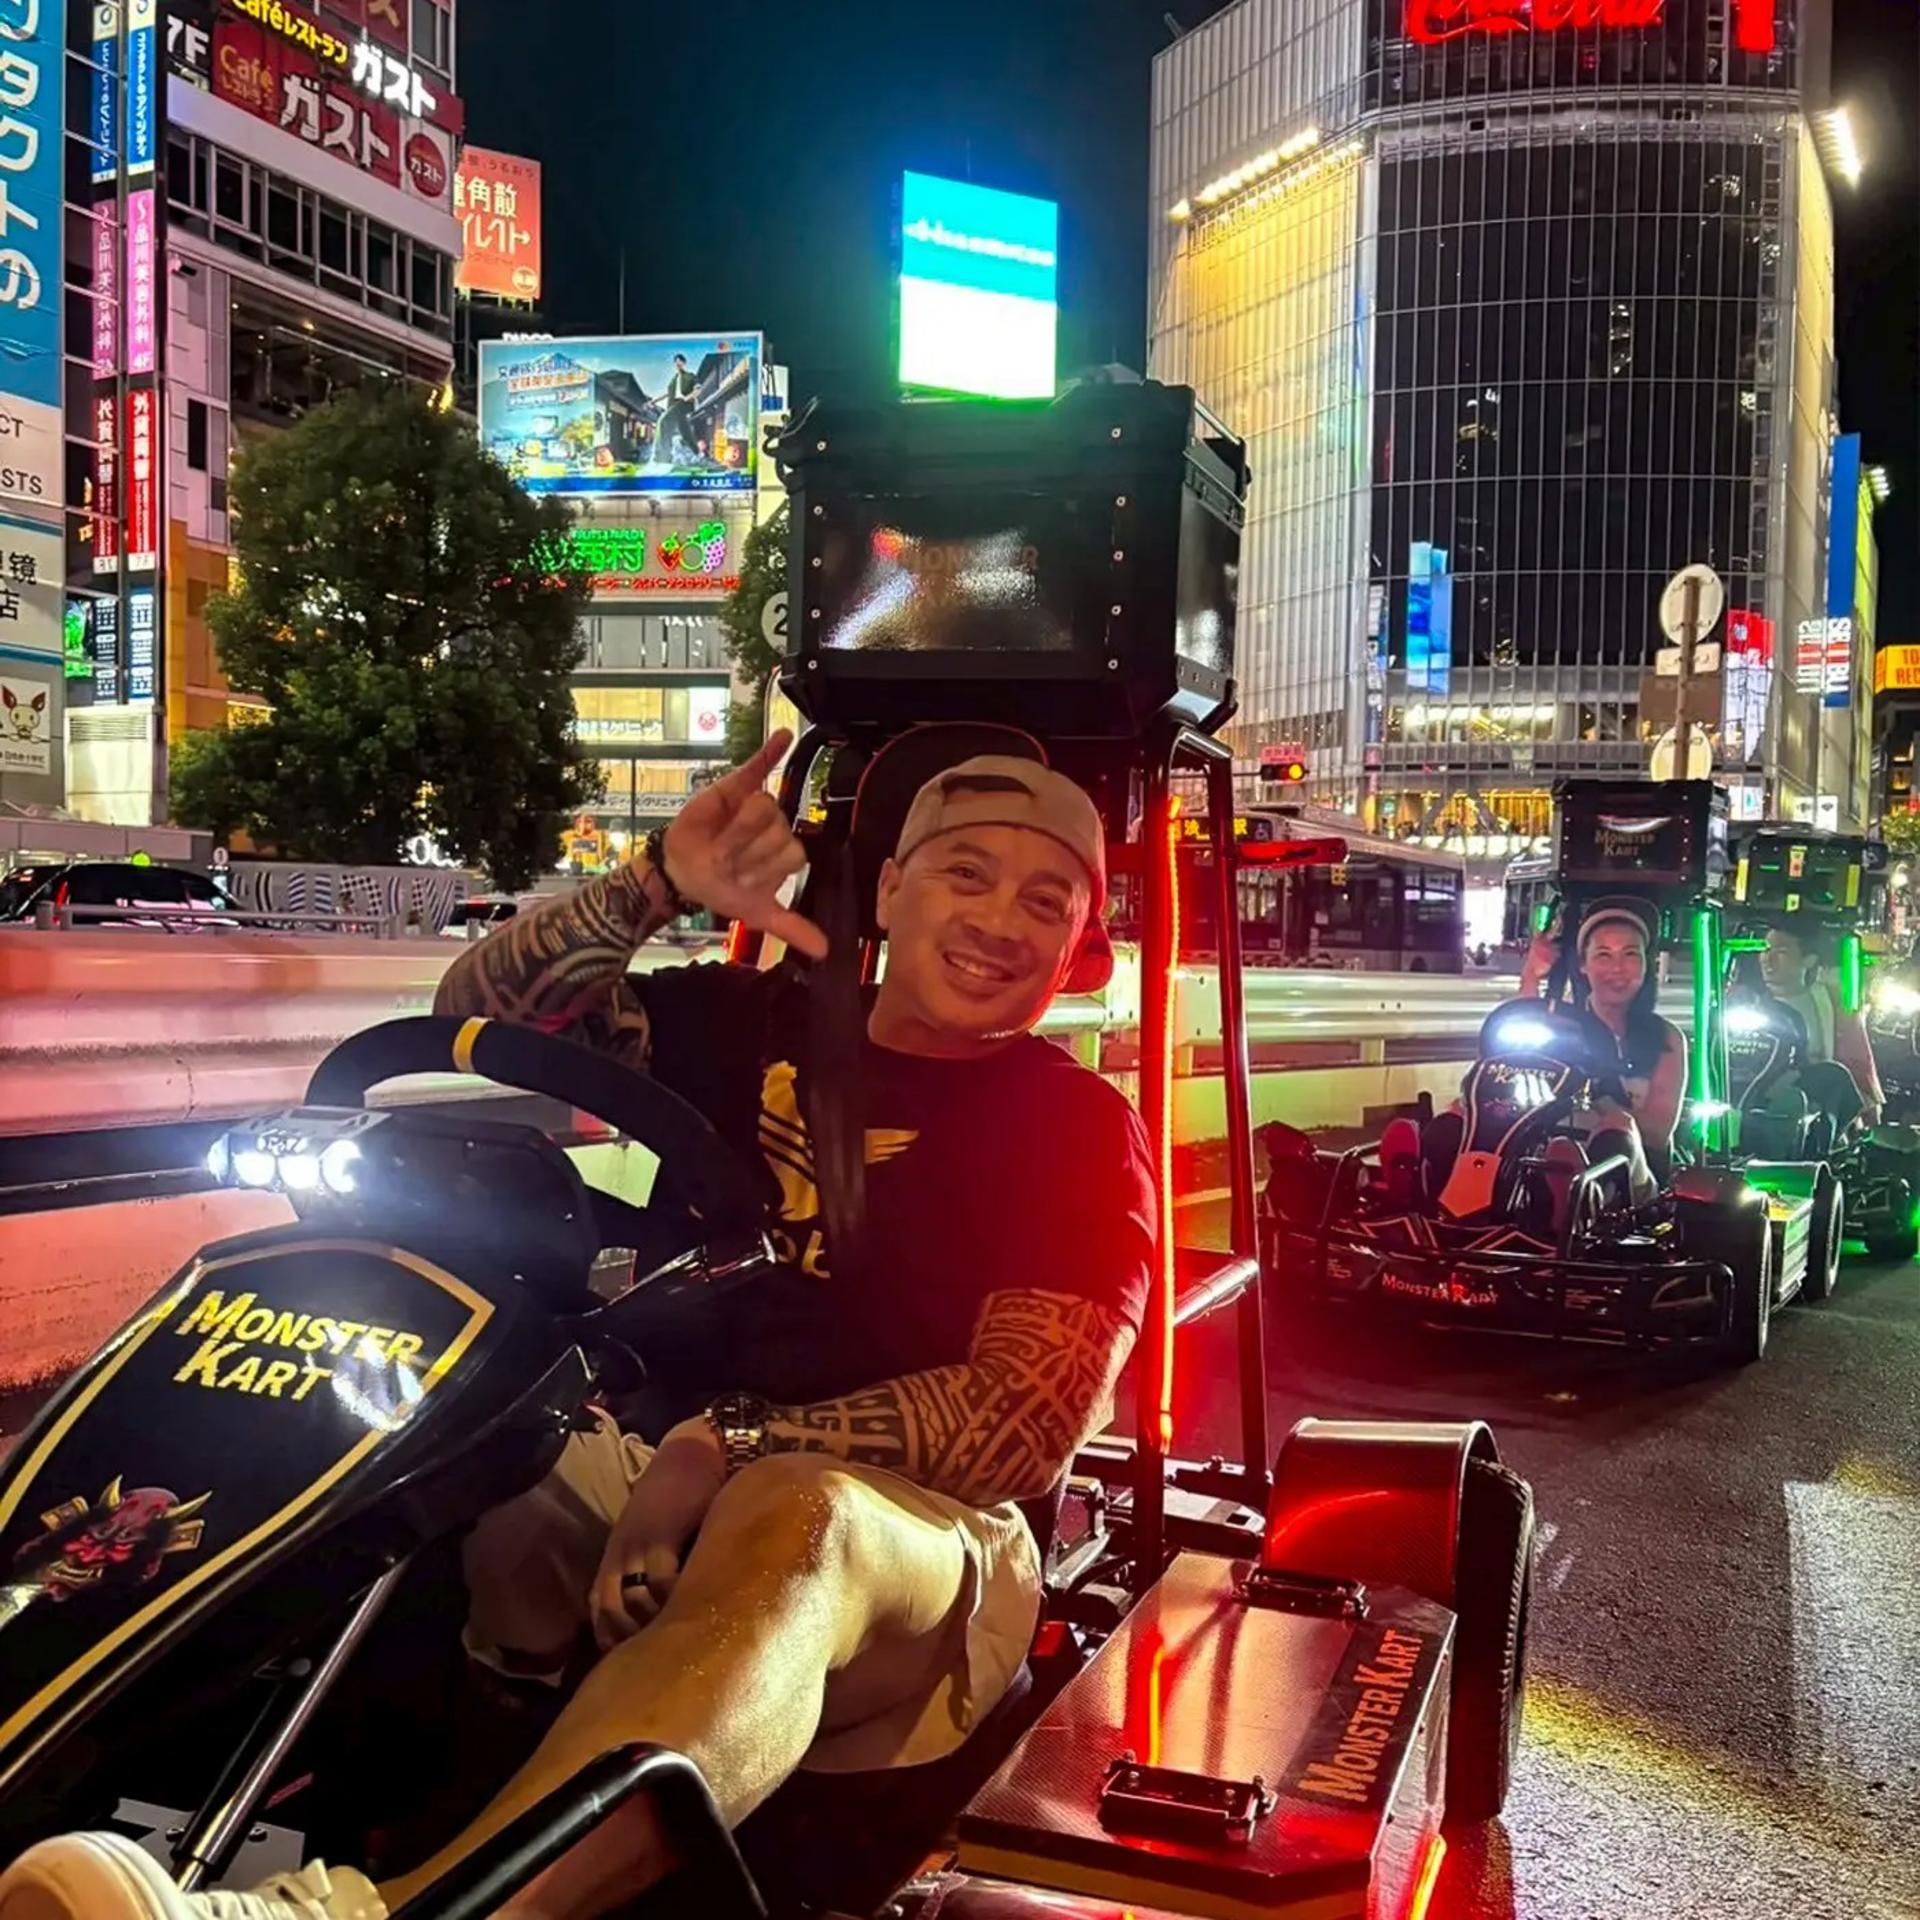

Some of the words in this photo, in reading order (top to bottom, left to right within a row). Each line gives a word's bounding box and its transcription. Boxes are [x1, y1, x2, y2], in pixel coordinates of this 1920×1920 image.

[166, 14, 210, 64] 7F
[352, 42, 436, 118] ガスト
[280, 74, 390, 168] ガスト
[175, 1290, 424, 1364] MONSTER
[173, 1337, 333, 1400] KART
[1298, 1688, 1406, 1803] MONSTER
[1353, 1628, 1424, 1689] KART
